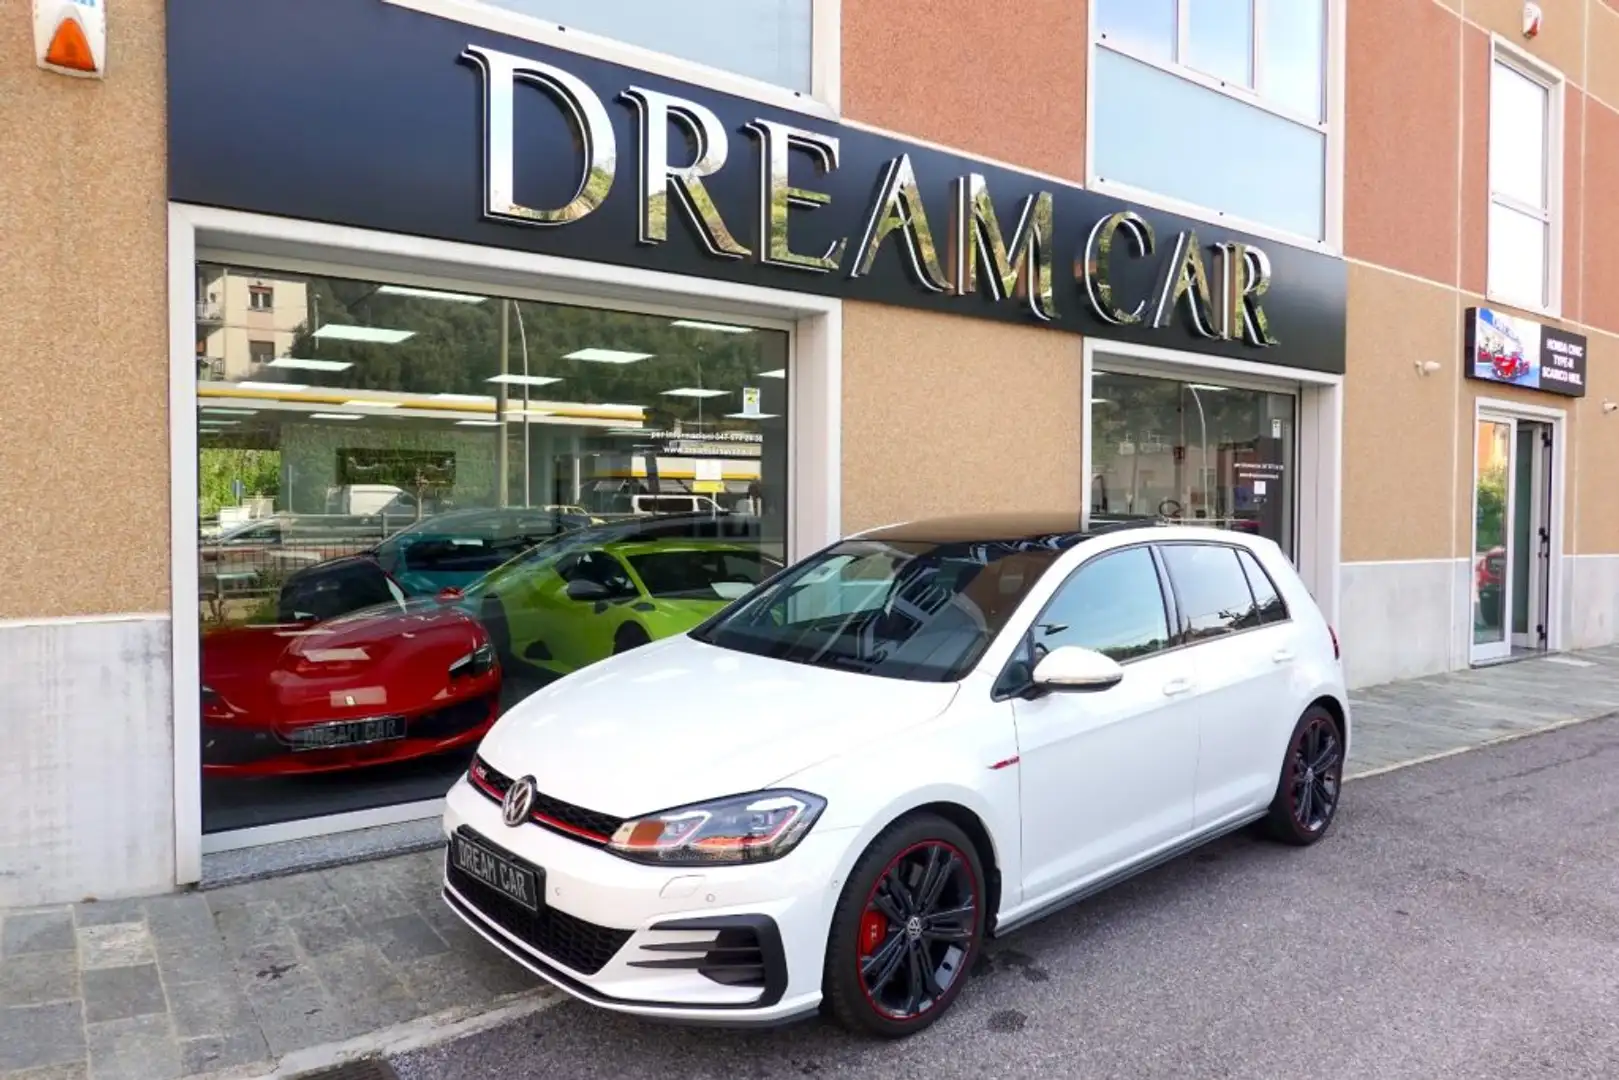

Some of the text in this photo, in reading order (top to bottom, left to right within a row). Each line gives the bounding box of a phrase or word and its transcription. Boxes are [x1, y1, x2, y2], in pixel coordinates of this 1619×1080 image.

[459, 44, 1279, 347] DREAM CAR
[365, 719, 396, 741] CAR
[458, 839, 528, 901] DREAM CAR
